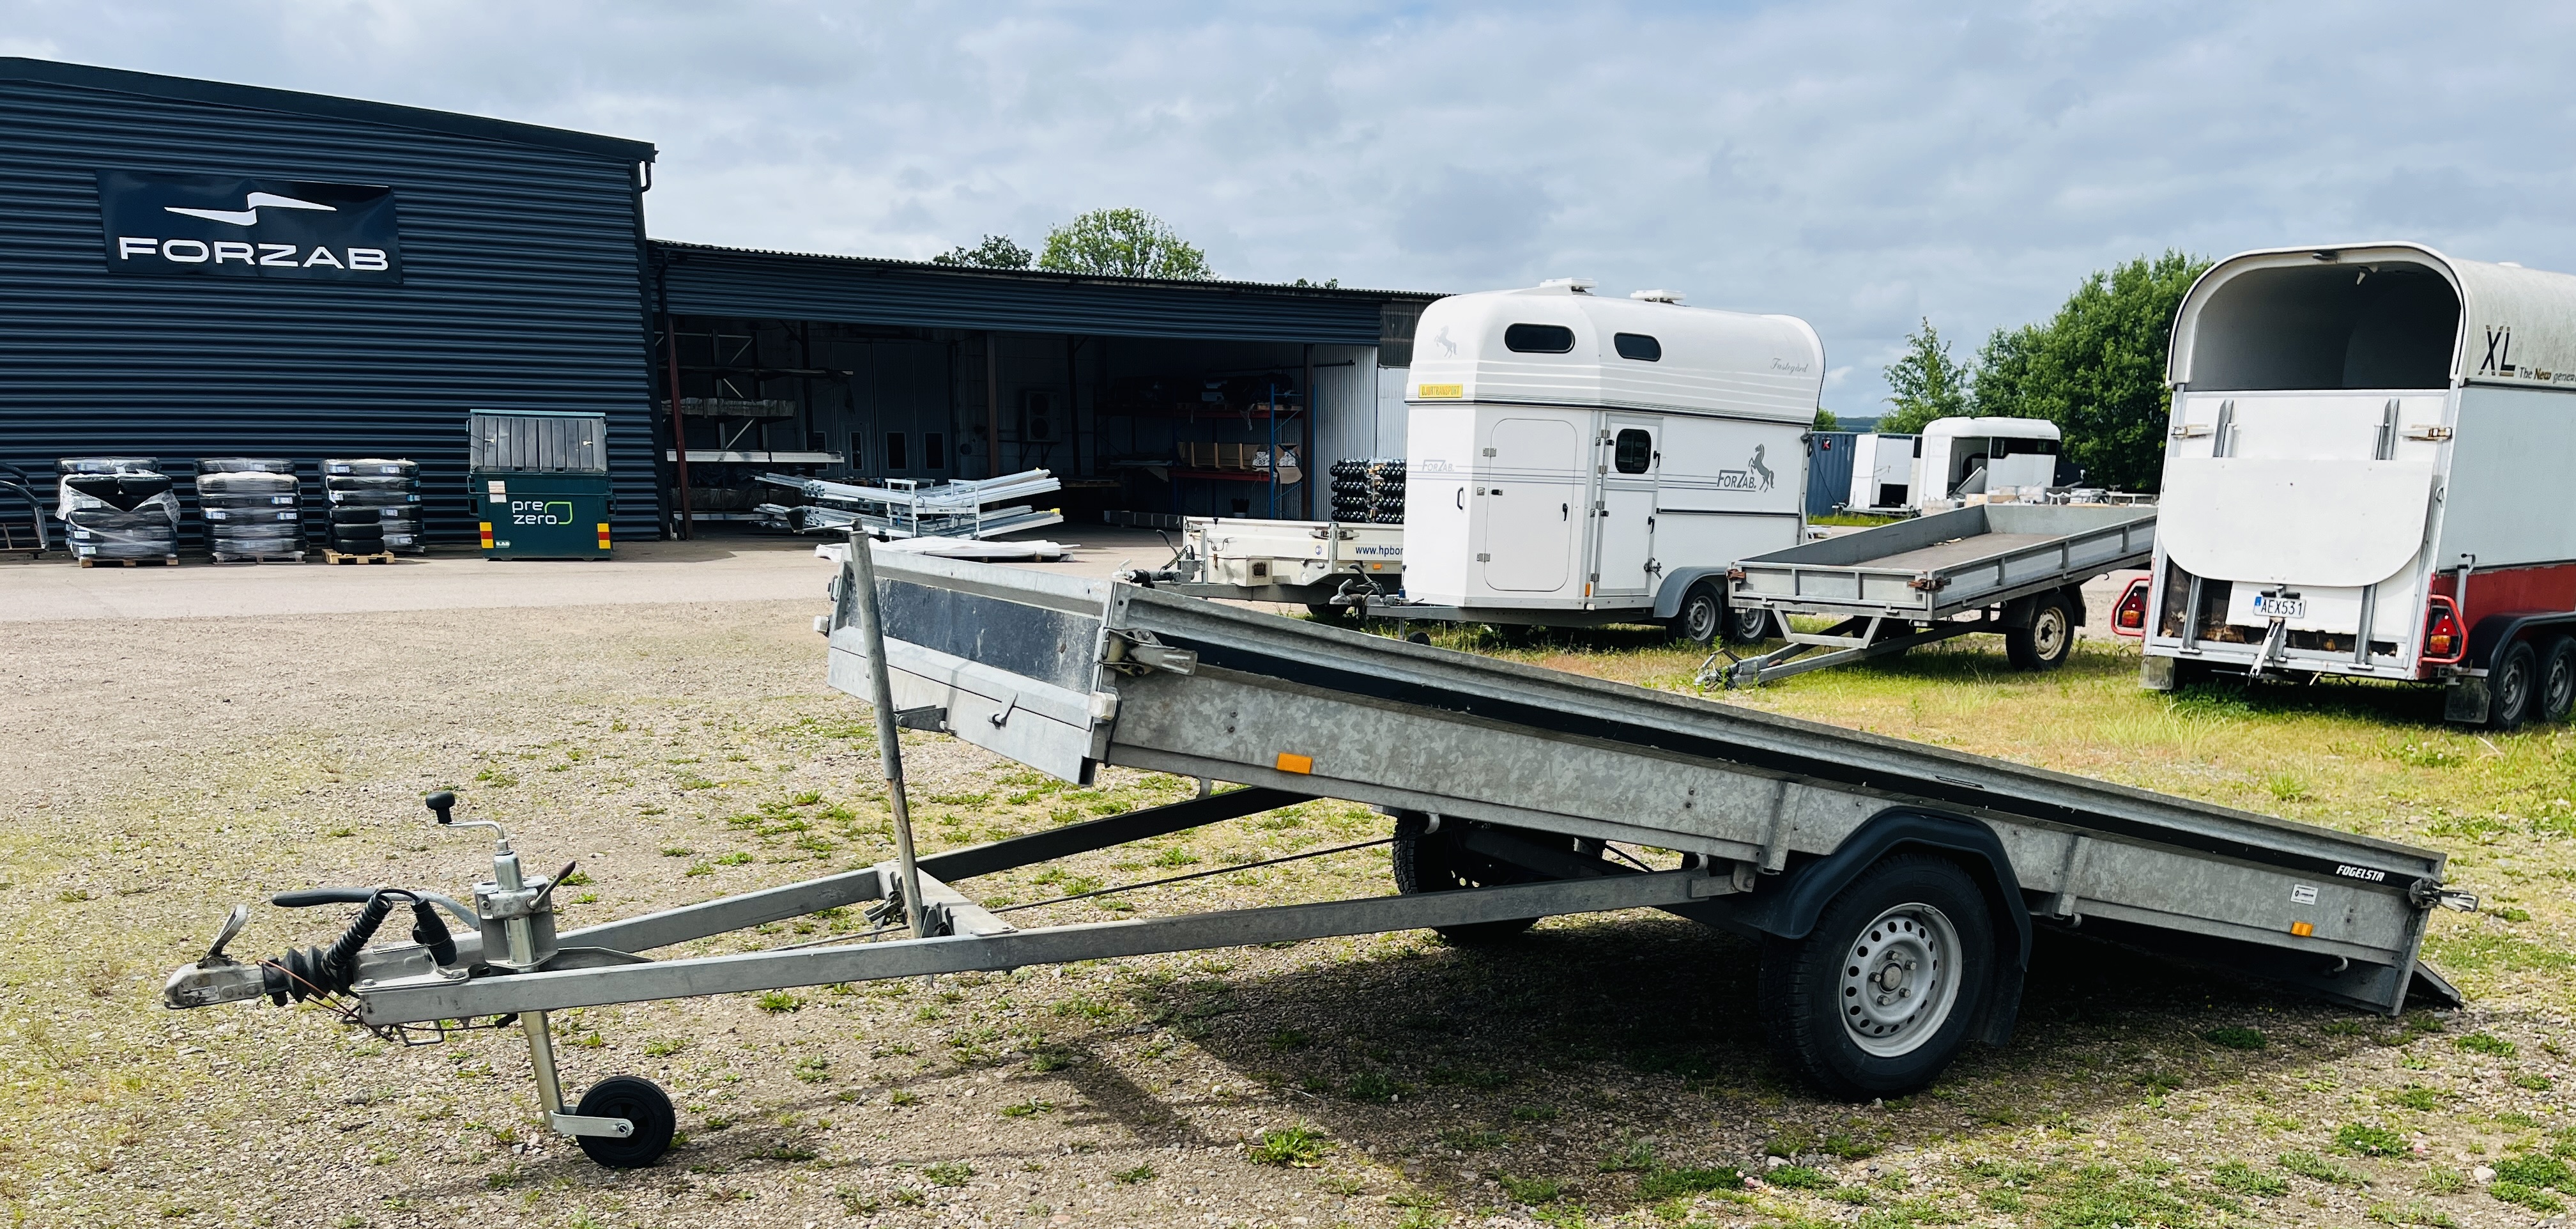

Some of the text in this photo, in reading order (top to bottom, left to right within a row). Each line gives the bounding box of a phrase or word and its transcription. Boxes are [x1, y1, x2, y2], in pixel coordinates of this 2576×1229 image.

[118, 236, 389, 271] FORZAB
[2478, 325, 2516, 377] XL
[2520, 366, 2533, 379] The
[2533, 367, 2552, 381] New
[512, 501, 544, 514] pre
[513, 514, 557, 525] zero
[2261, 599, 2303, 615] AEX531
[2336, 865, 2385, 882] FOGELSTA
